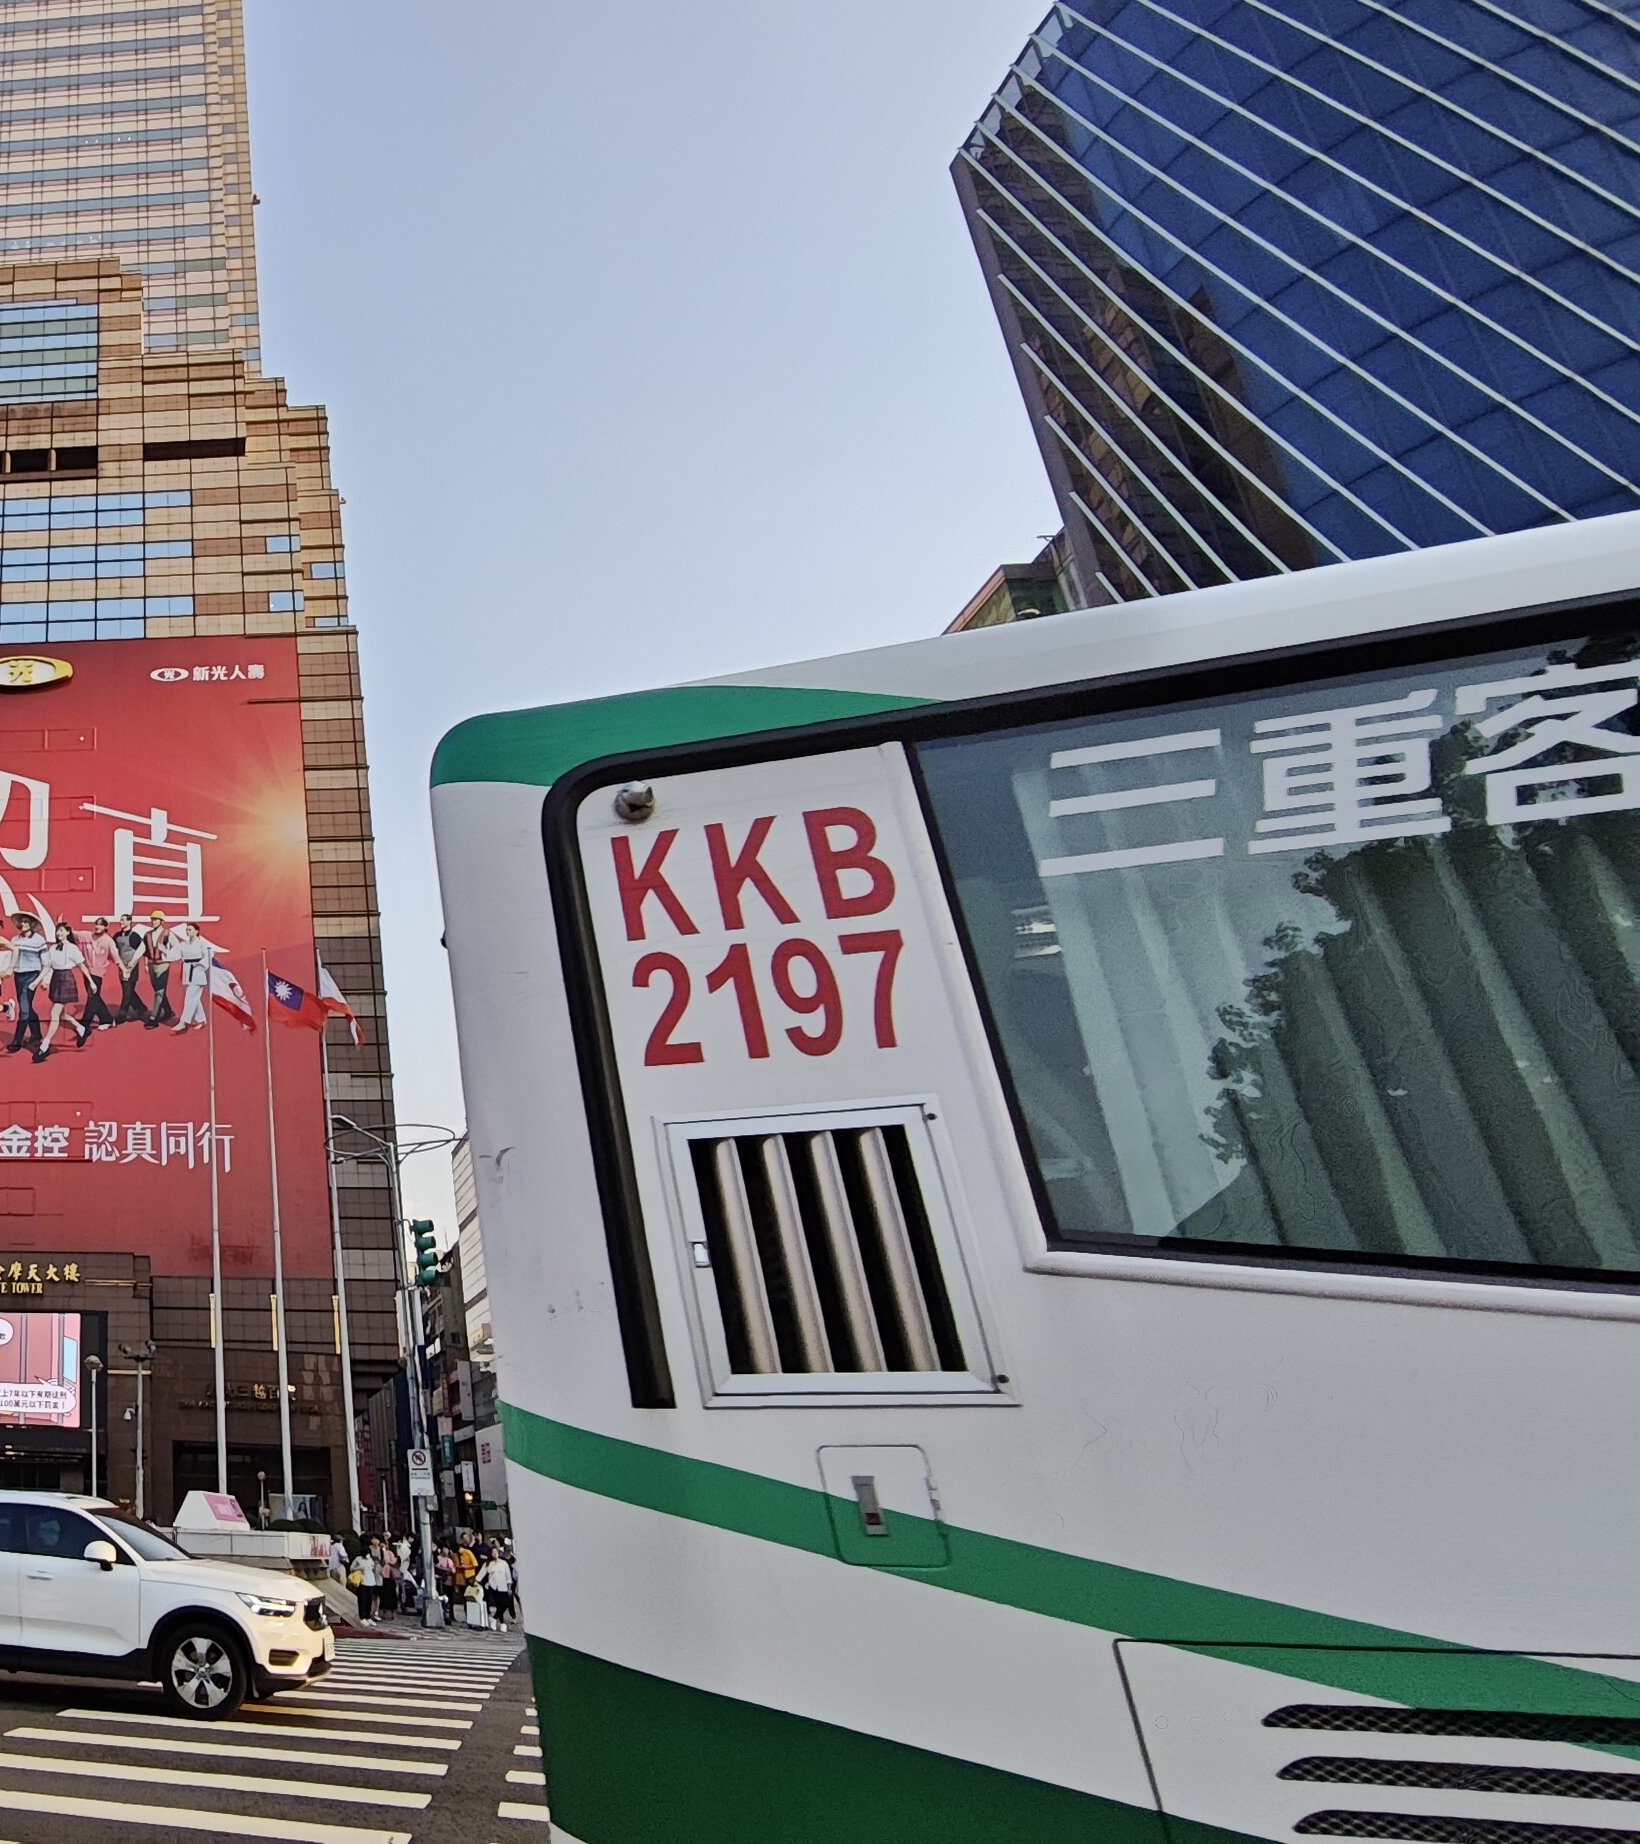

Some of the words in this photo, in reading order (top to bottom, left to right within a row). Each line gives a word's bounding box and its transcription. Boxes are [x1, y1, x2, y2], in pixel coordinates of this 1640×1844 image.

[192, 664, 265, 682] 新光人壽
[1038, 661, 1640, 877] 三重客
[610, 806, 897, 941] KKB
[630, 928, 905, 1067] 2197
[83, 1120, 235, 1174] 認真同行
[11, 1282, 44, 1294] TOWER
